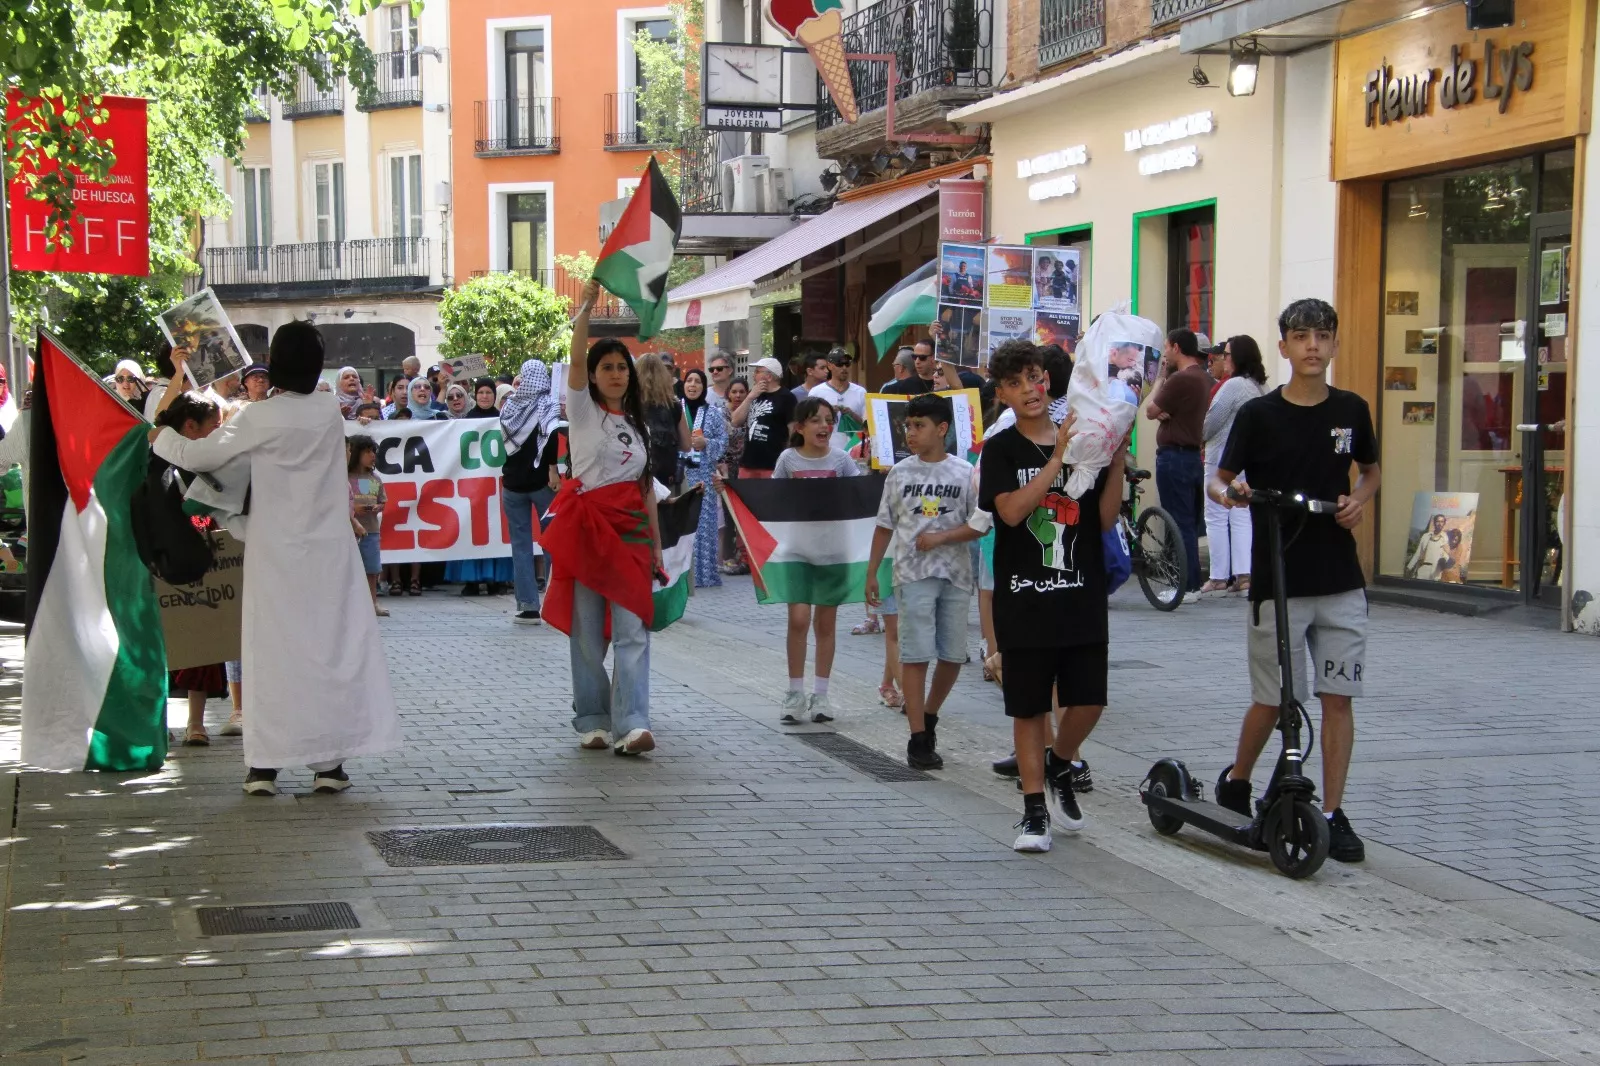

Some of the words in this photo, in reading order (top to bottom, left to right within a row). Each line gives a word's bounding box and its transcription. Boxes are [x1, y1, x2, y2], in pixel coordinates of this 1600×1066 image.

[1365, 65, 1432, 127] Fleur
[1440, 44, 1475, 109] de
[1483, 38, 1534, 114] Lys
[724, 110, 764, 119] JOYERIA
[719, 118, 769, 128] RELOJERIA
[72, 189, 89, 201] DE
[90, 190, 136, 204] HUESCA
[948, 209, 976, 218] Turrón
[902, 484, 962, 499] PIKACHU
